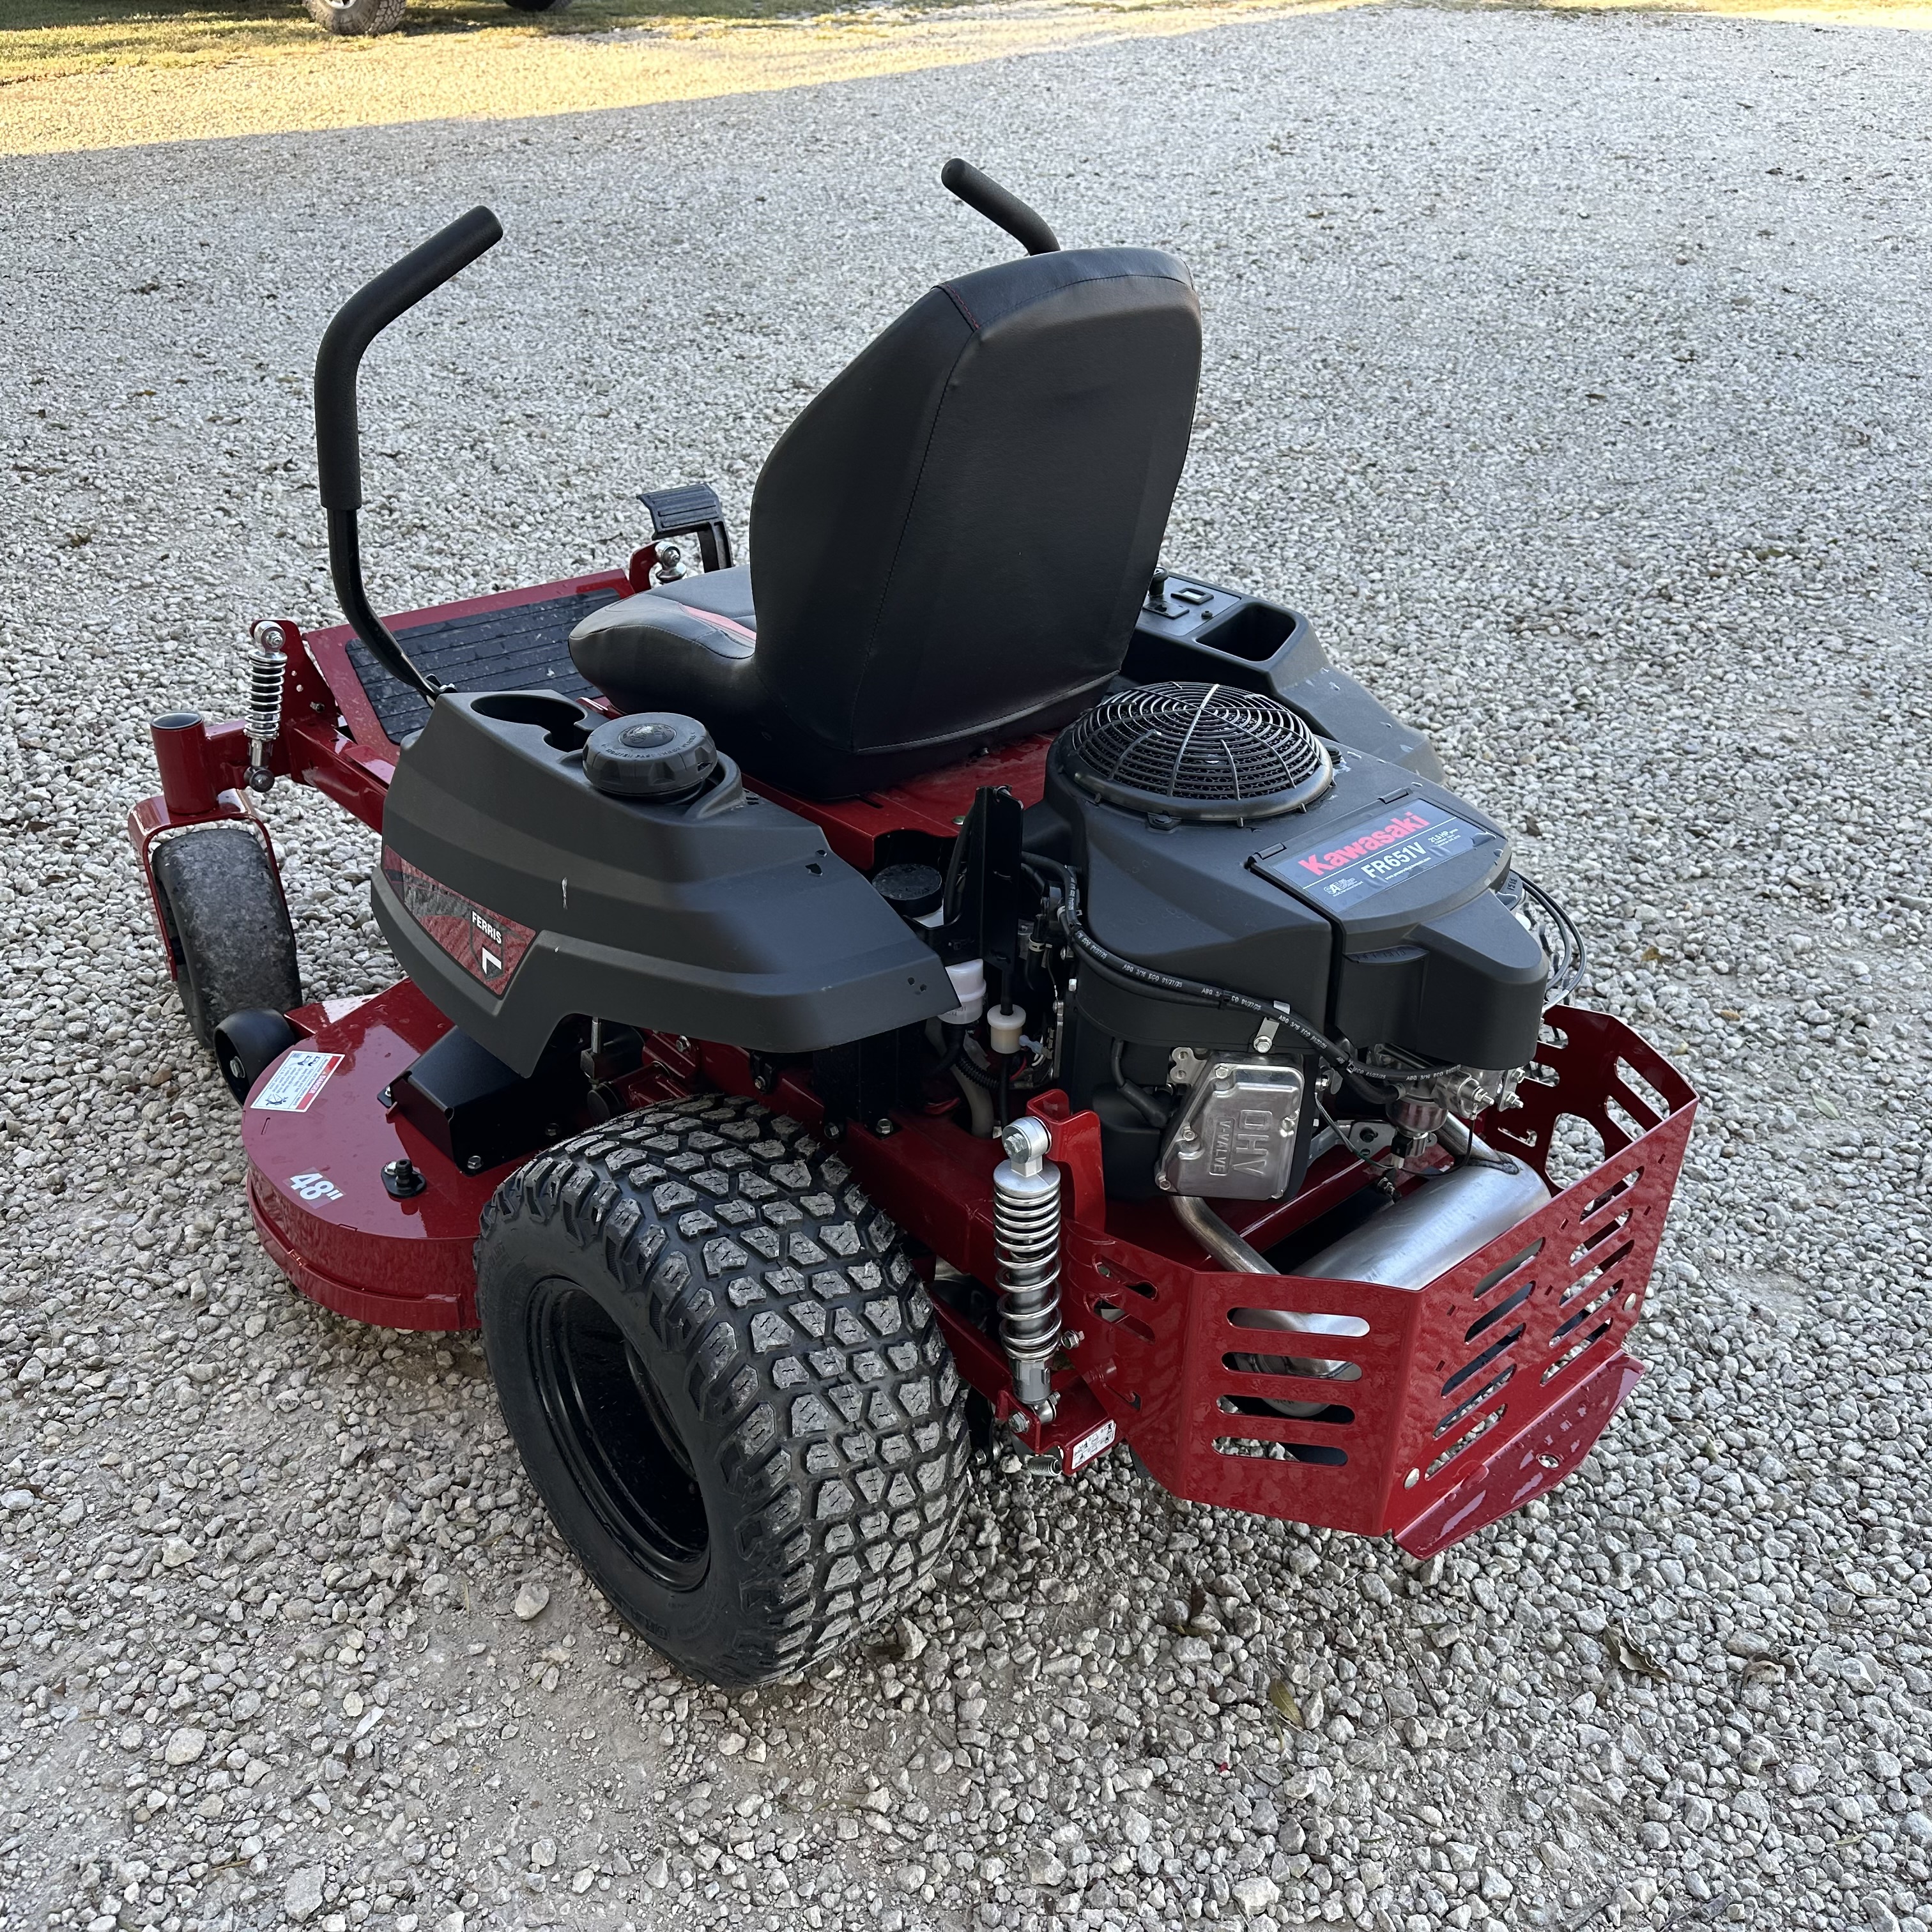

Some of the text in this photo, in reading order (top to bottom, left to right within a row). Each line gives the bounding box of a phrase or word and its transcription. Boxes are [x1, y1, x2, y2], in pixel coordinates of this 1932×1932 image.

[1298, 811, 1430, 876] Kawasaki
[1361, 841, 1427, 878] FR651V
[471, 910, 502, 944] FERRIS
[1148, 973, 1160, 982] ECO
[1231, 995, 1239, 1004] CO
[1300, 1028, 1311, 1038] ECO
[308, 1075, 327, 1094] DANGER
[1214, 1120, 1232, 1172] V-VALVE
[1232, 1109, 1273, 1178] OHV
[289, 1172, 344, 1200] 48"
